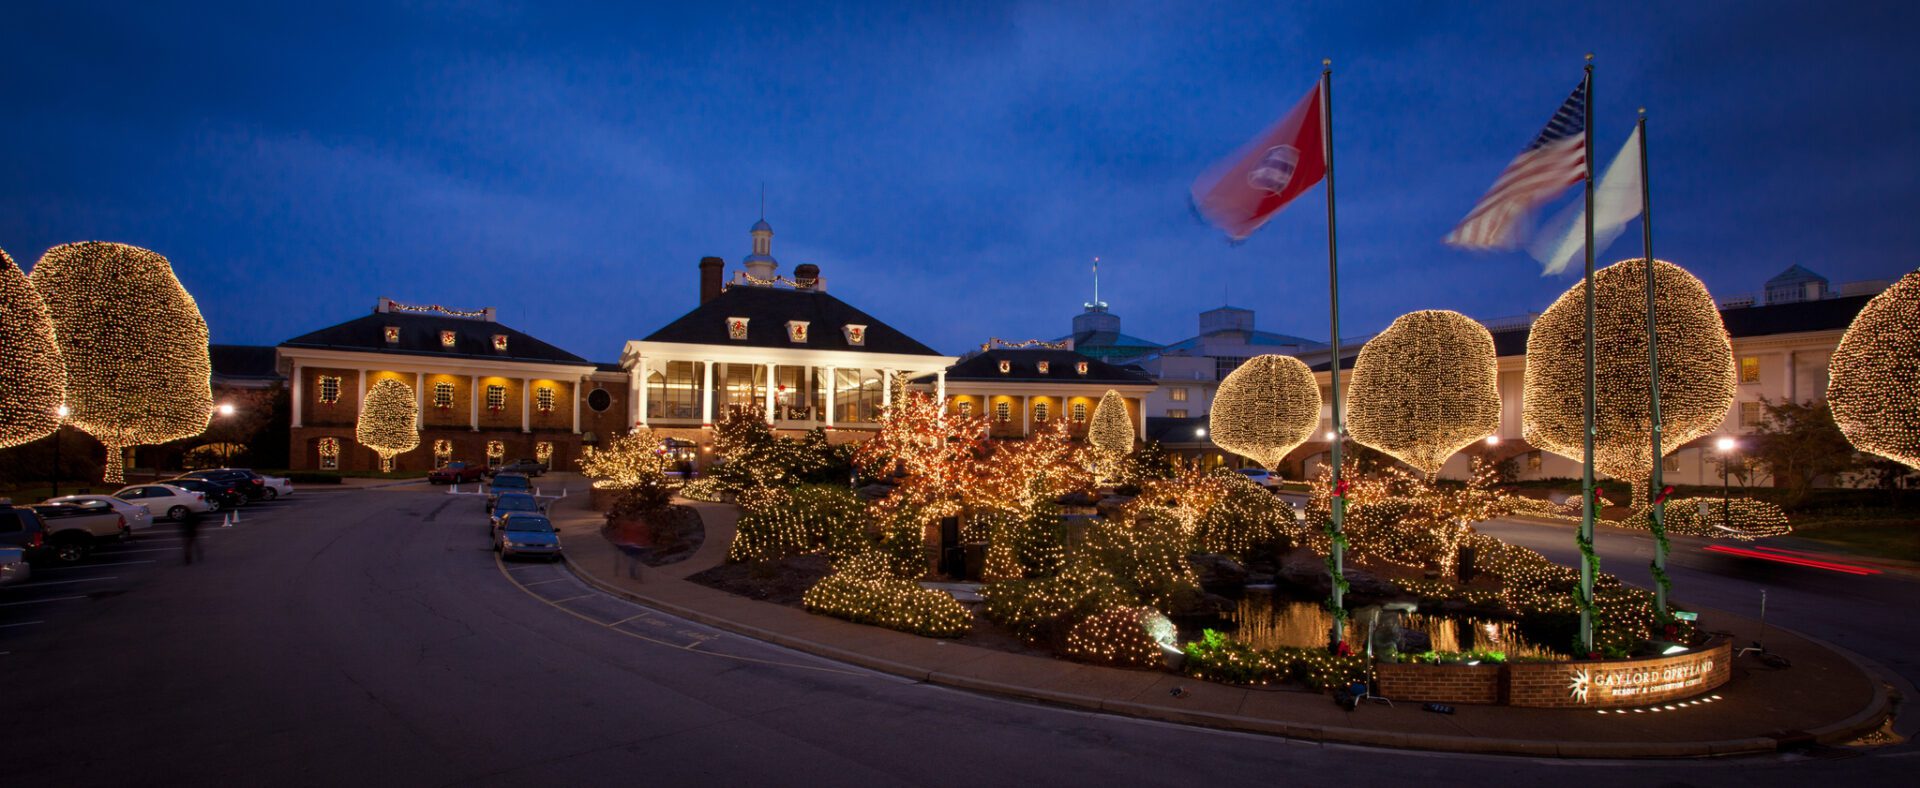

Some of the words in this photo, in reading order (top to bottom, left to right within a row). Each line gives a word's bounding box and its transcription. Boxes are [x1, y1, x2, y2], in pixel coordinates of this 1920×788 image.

[1594, 671, 1659, 687] GAYLORD
[1663, 661, 1713, 681] OPRYLAND
[1612, 687, 1640, 696] RESORT
[1650, 682, 1684, 693] CONVENTION
